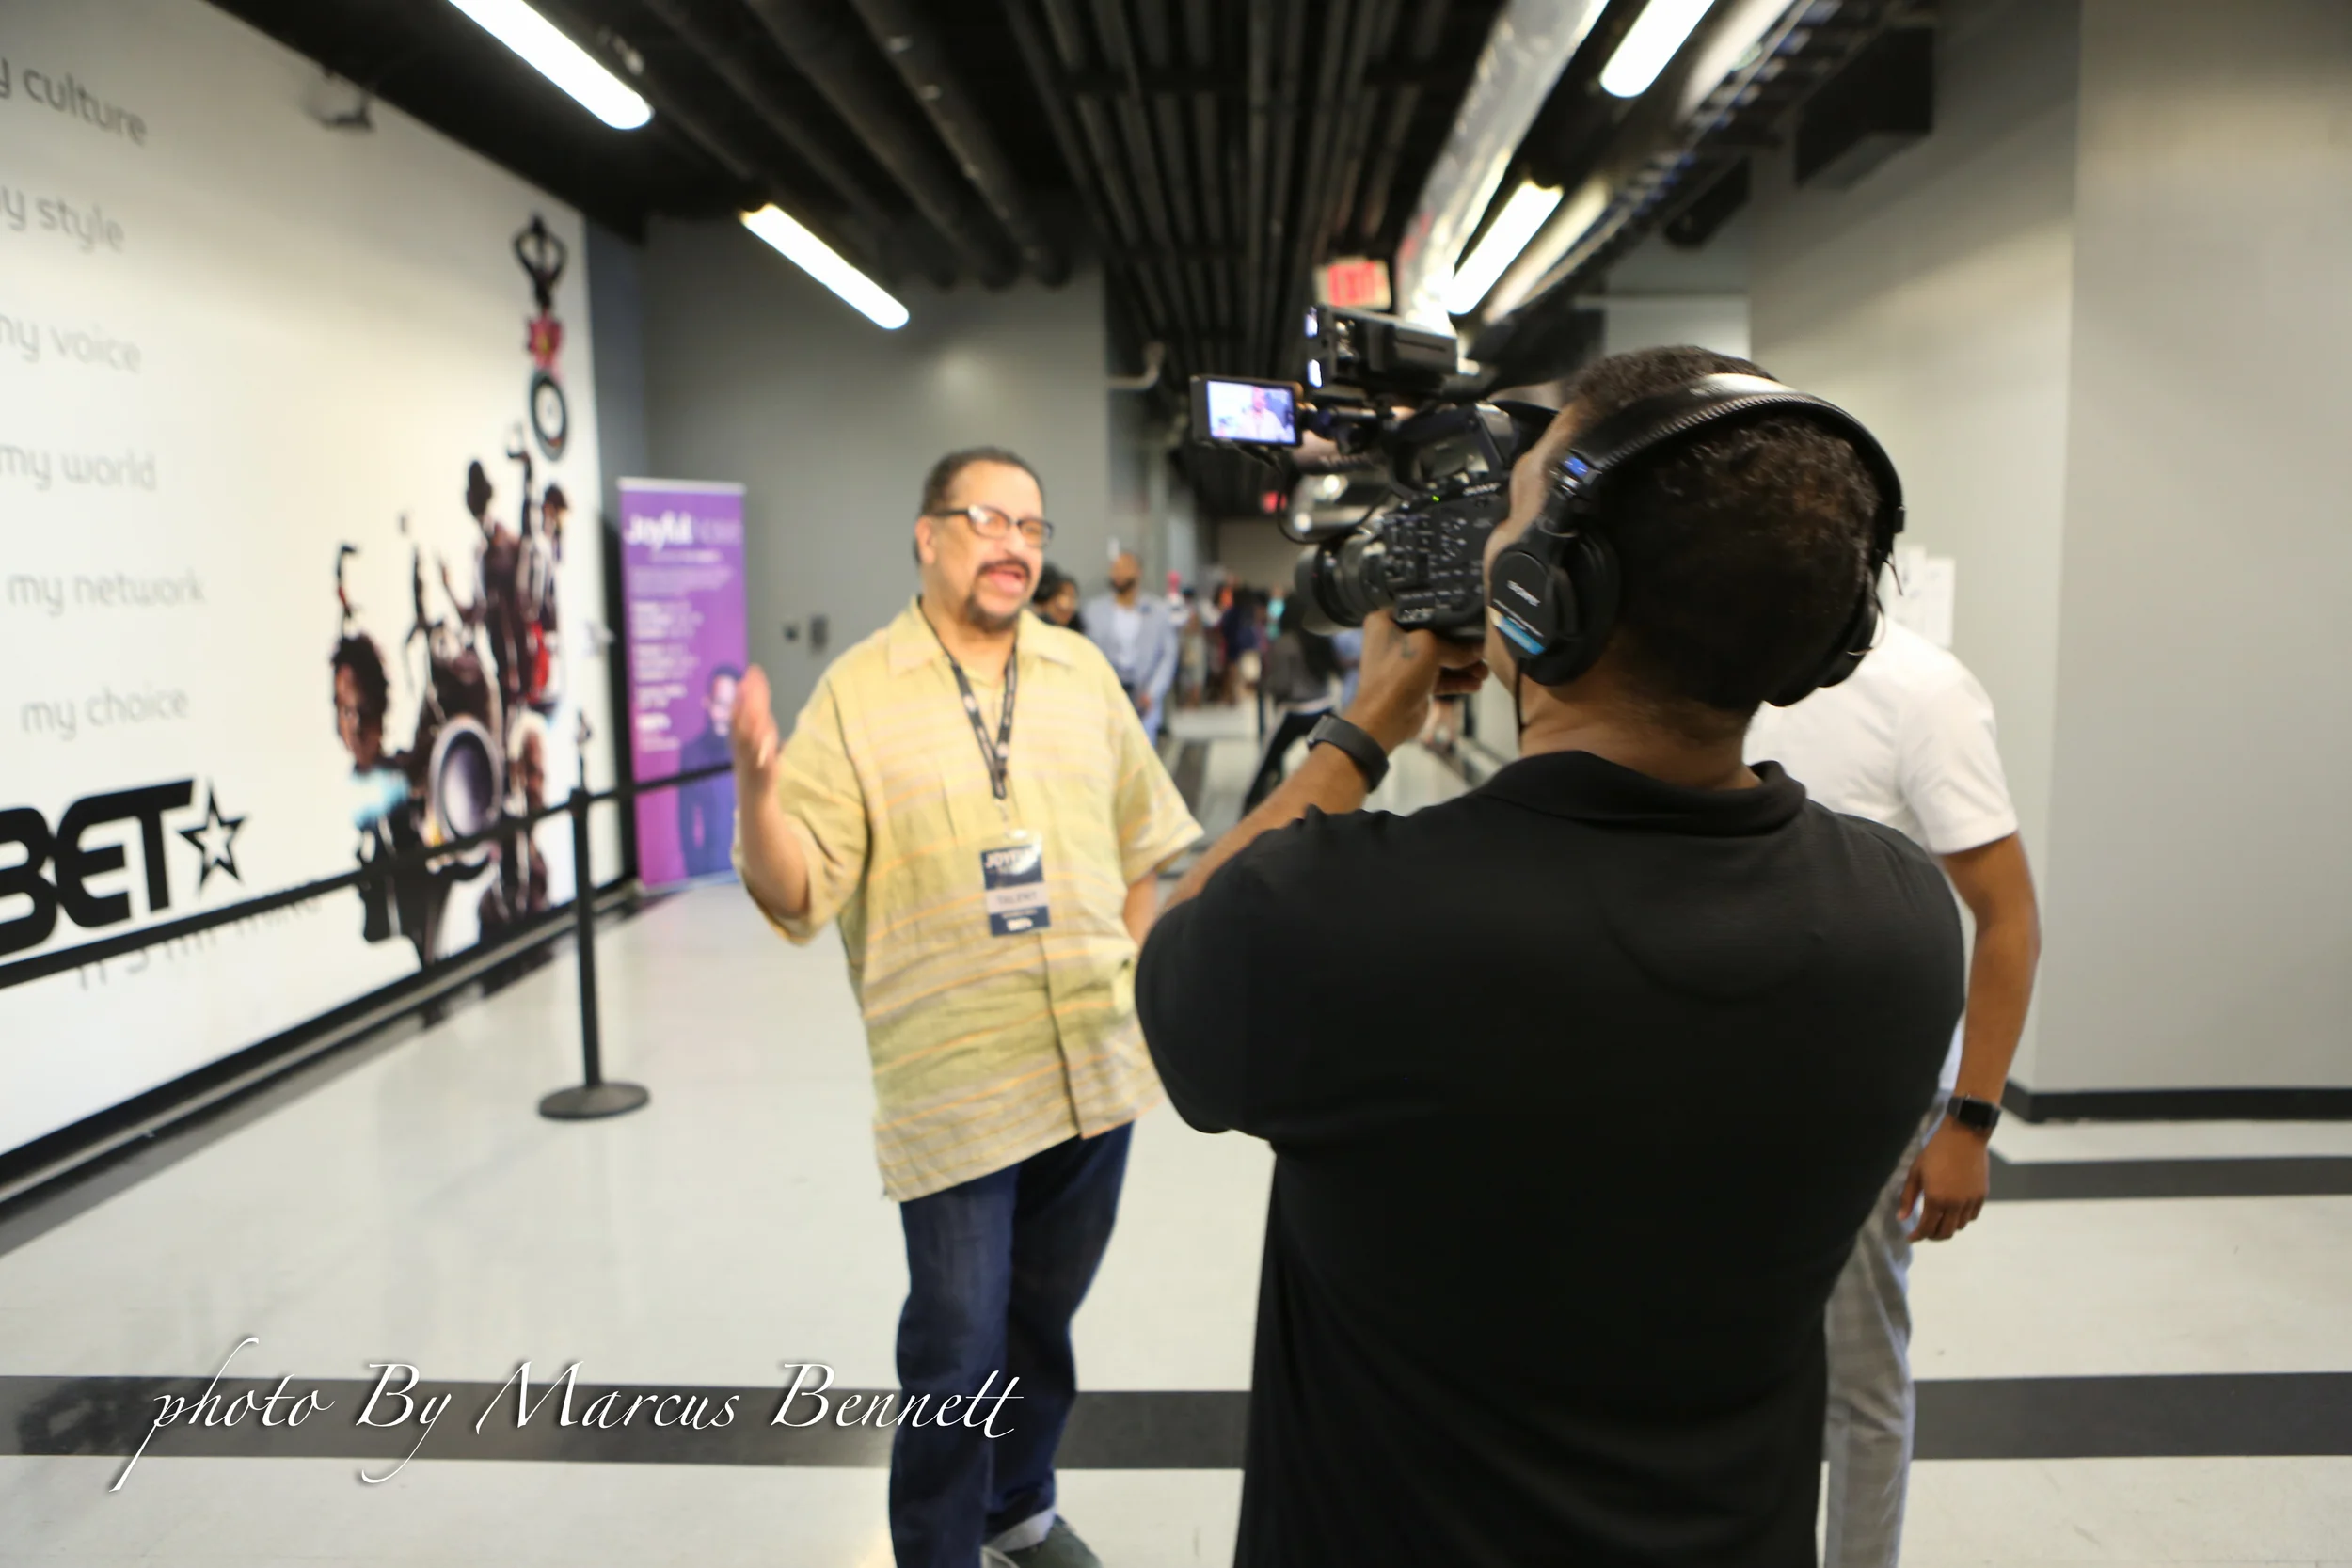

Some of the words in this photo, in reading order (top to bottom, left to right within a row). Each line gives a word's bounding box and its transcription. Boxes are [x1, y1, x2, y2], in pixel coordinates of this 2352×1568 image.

[23, 68, 147, 146] culture
[35, 195, 125, 252] style
[50, 324, 142, 373] voice
[0, 444, 51, 491] my
[61, 448, 158, 491] world
[8, 573, 64, 617] my
[74, 567, 205, 607] network
[22, 701, 77, 741] my
[86, 687, 189, 727] choice
[0, 777, 196, 957] BET
